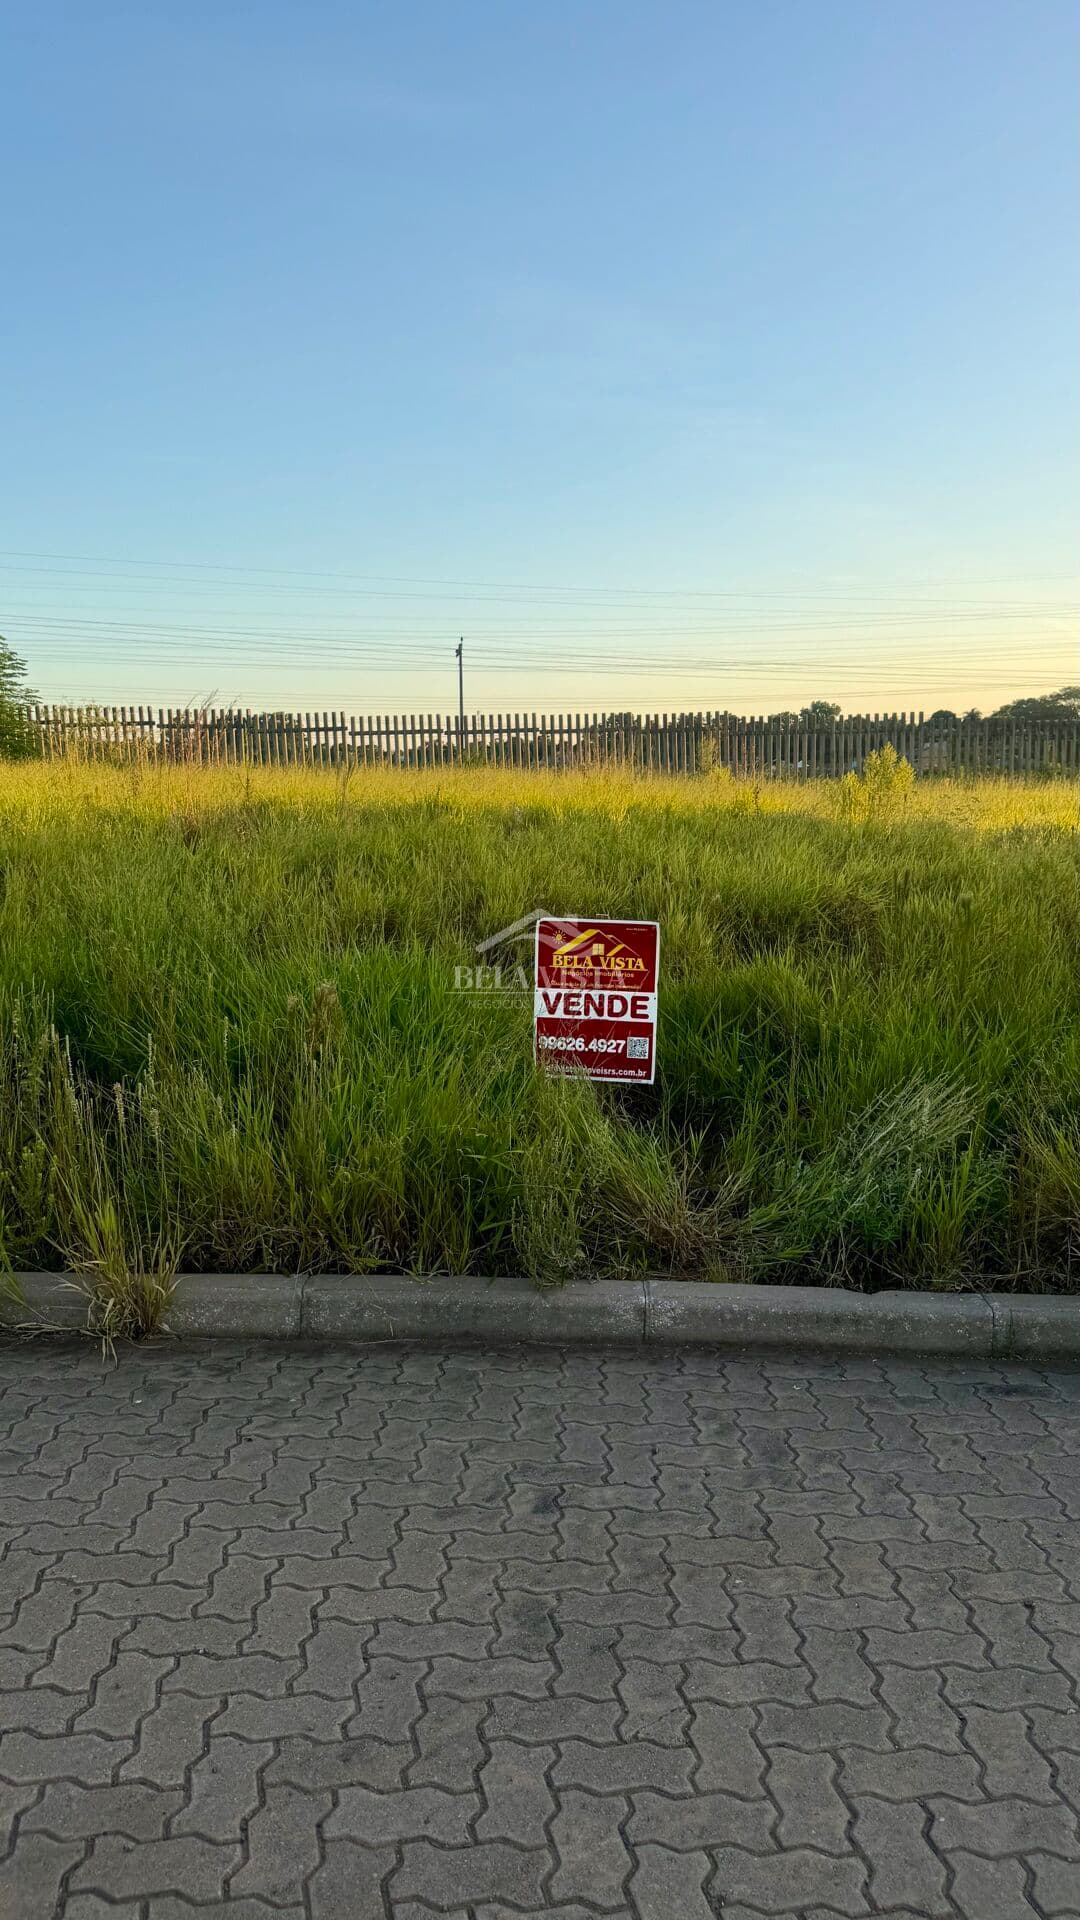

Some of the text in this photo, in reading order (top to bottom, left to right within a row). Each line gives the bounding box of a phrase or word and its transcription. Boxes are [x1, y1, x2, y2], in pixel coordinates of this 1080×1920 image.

[552, 955, 645, 970] BELA VISTA
[543, 991, 649, 1020] VENDE
[538, 1036, 626, 1054] 99626.4927
